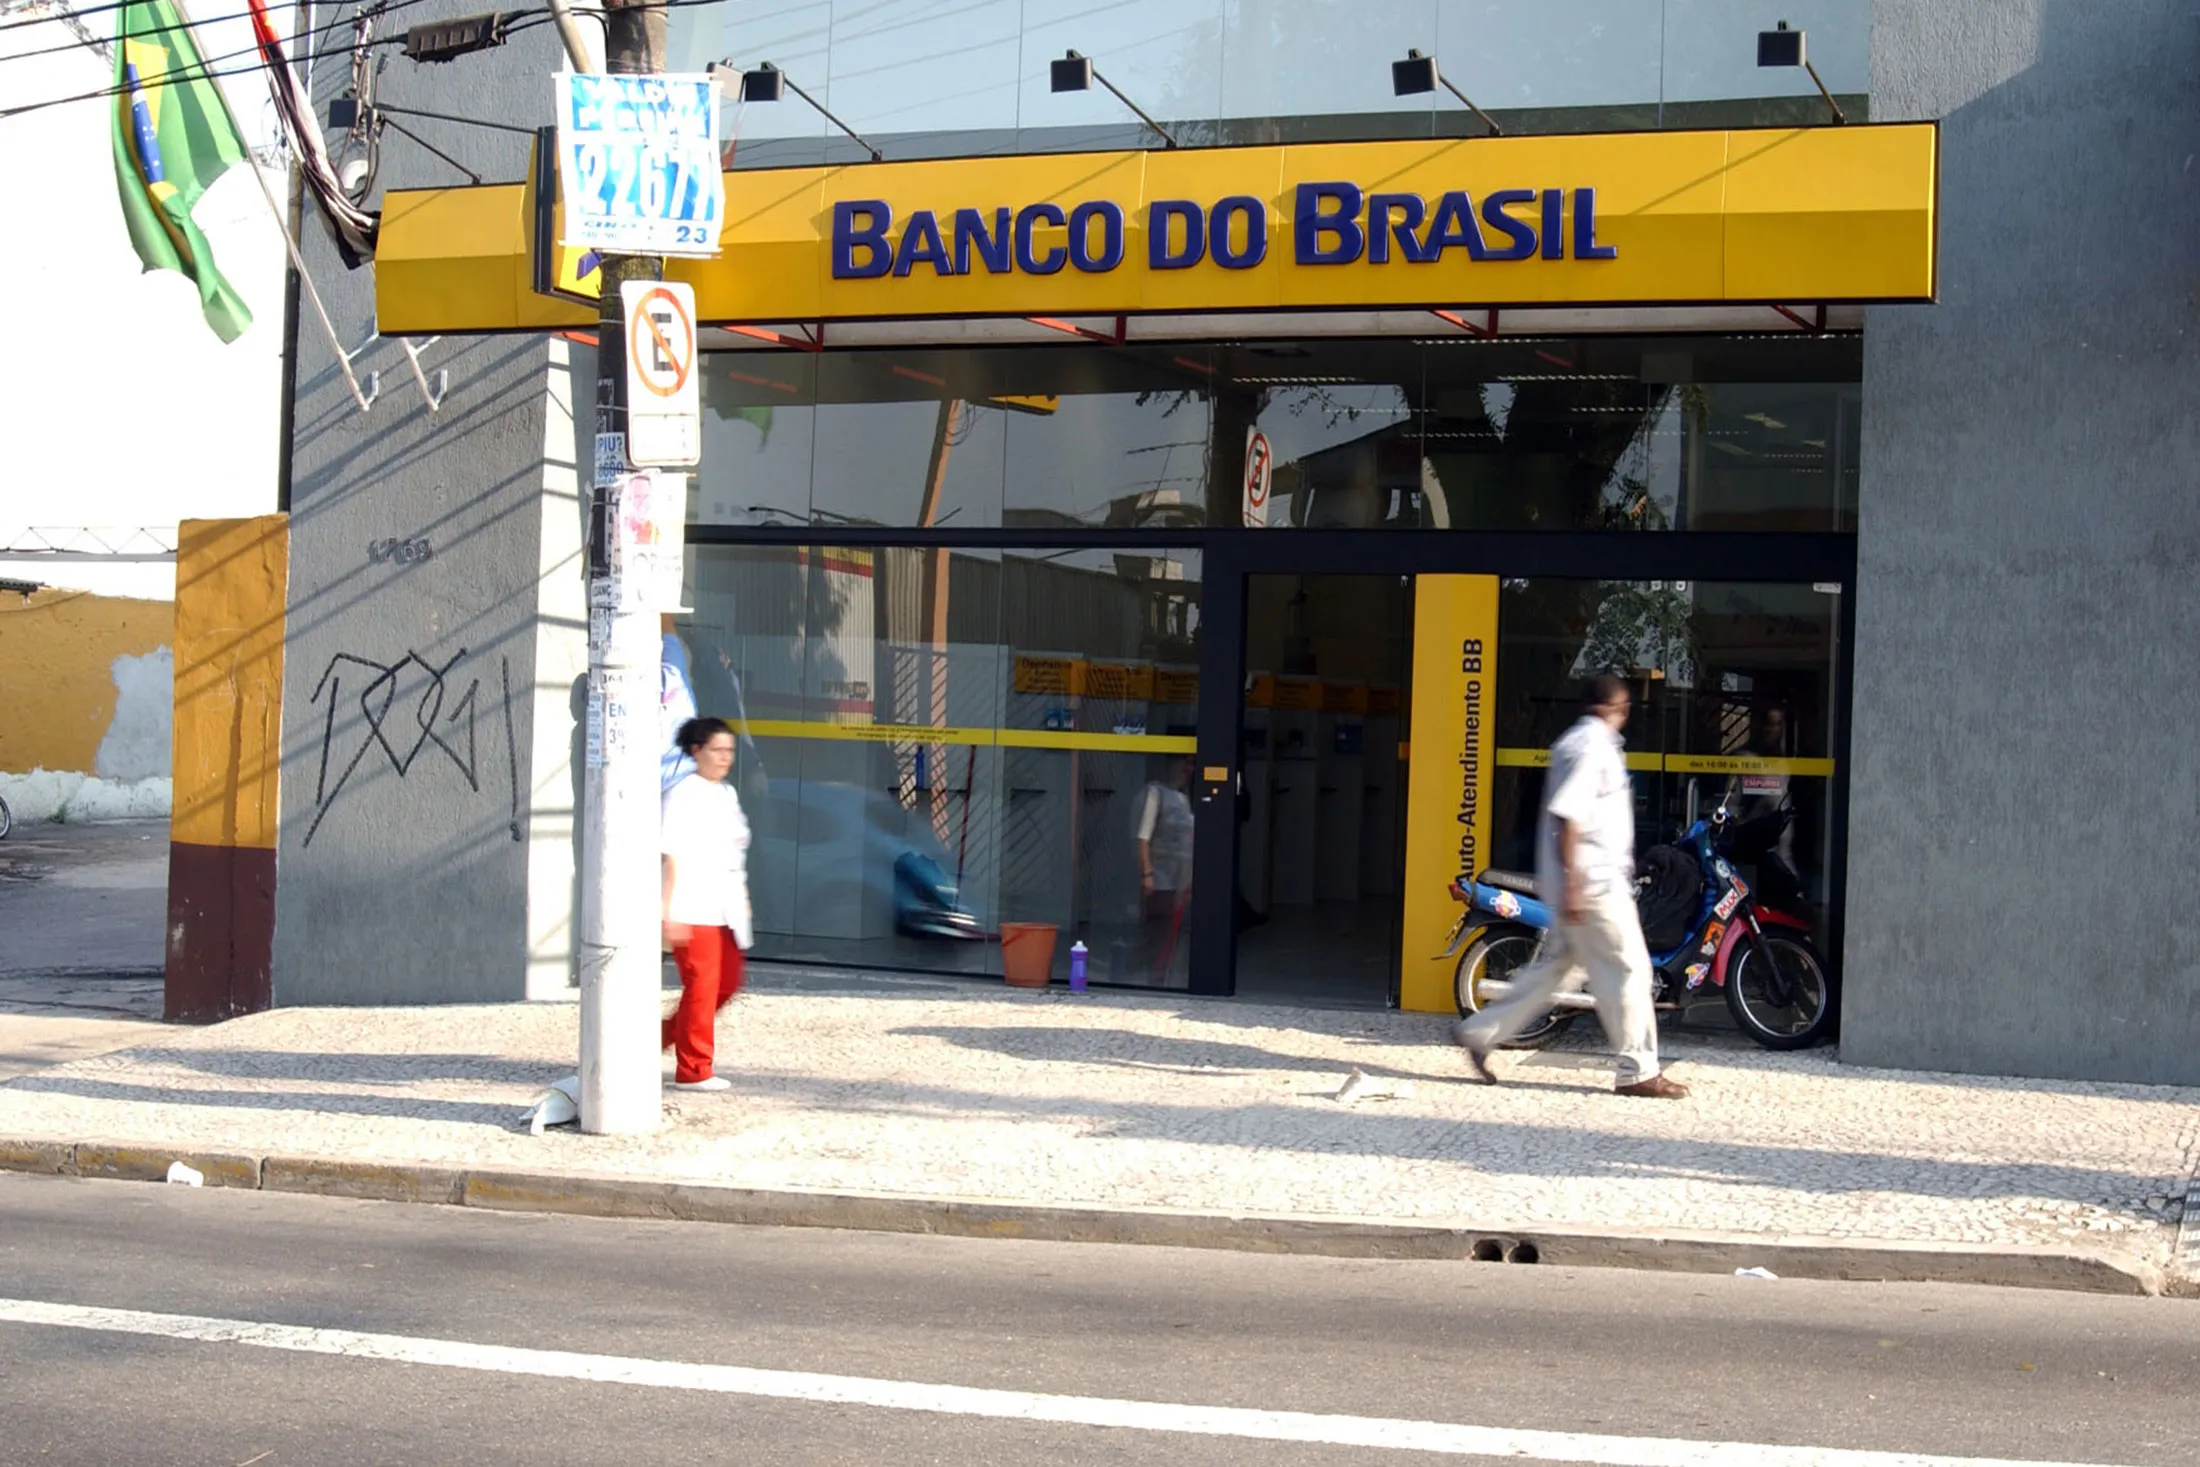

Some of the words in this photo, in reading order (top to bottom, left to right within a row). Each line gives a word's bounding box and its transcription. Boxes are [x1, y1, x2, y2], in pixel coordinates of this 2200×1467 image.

[676, 226, 708, 244] 23
[832, 199, 1125, 280] BANCO
[1149, 195, 1267, 270] DO
[1295, 182, 1617, 265] BRASIL
[1462, 637, 1483, 674] BB
[1455, 680, 1481, 889] Auto-Atendimento
